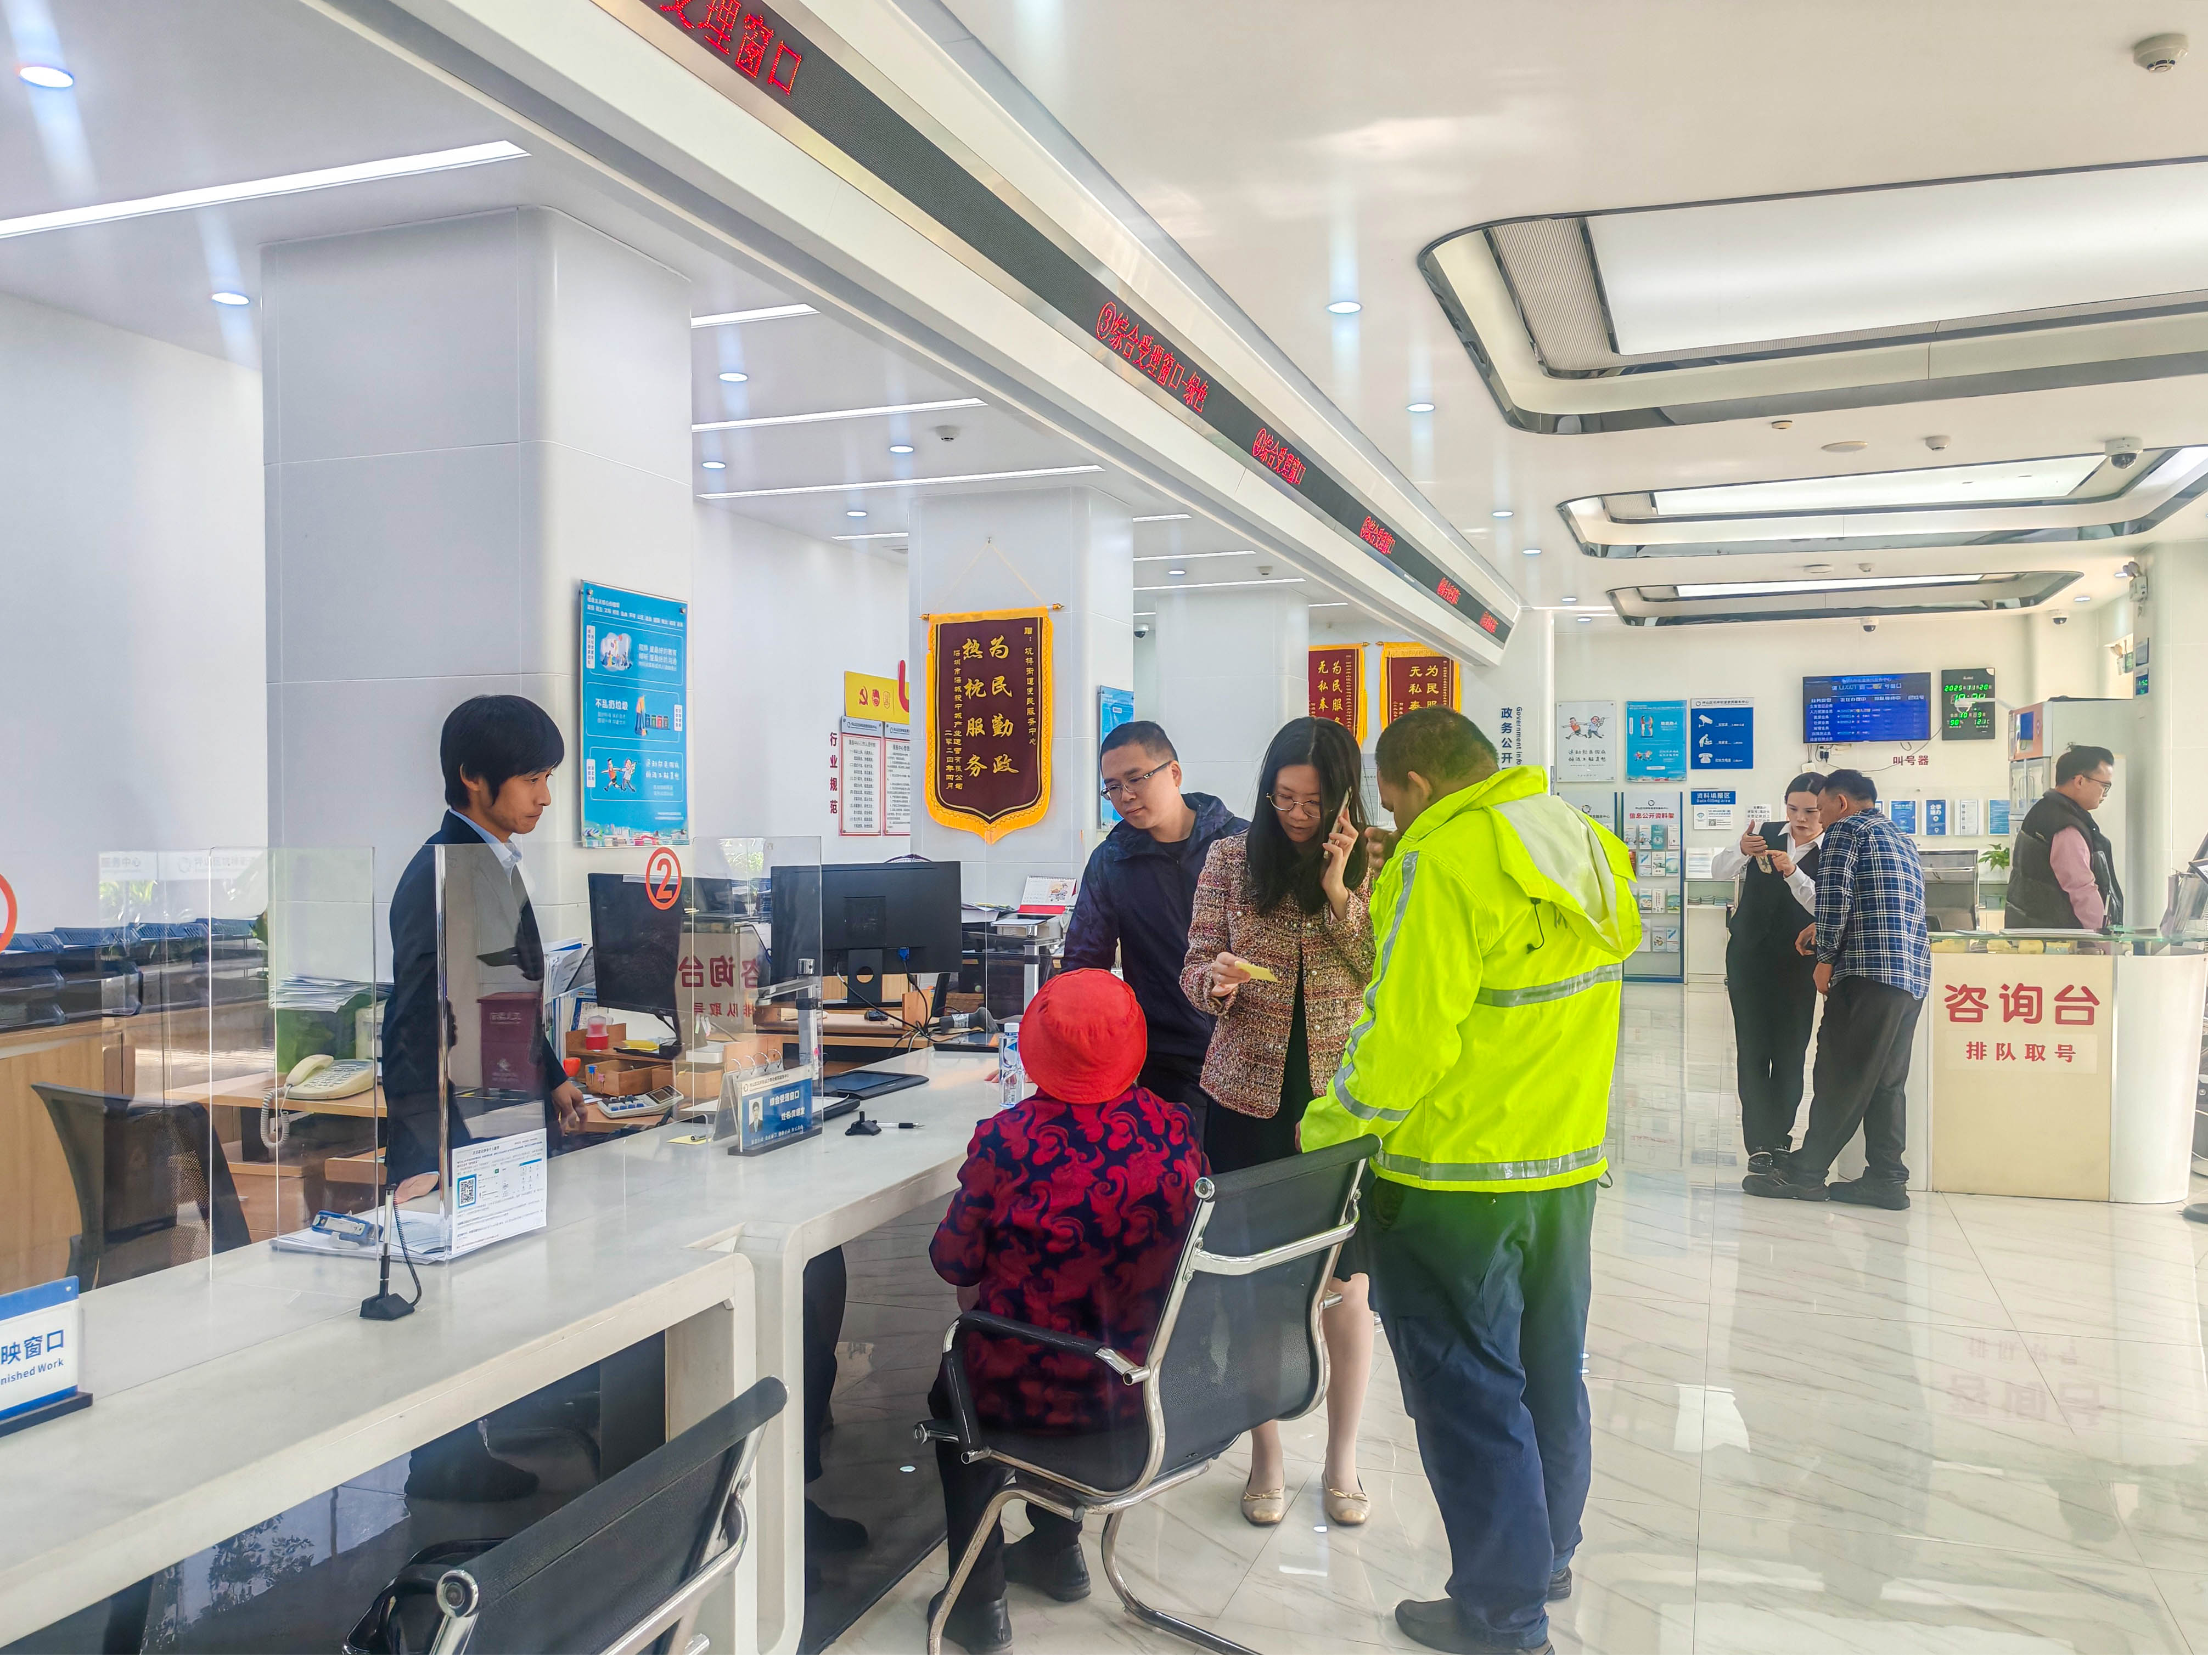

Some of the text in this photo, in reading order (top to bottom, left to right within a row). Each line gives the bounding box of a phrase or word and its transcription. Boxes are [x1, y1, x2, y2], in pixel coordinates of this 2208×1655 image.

[595, 698, 629, 711] 不乱扔垃圾
[989, 635, 1019, 774] 为民勤政
[1501, 707, 1513, 770] 政务公开
[829, 732, 838, 814] 行业规范
[1892, 755, 1929, 766] 叫号器
[1944, 982, 2101, 1026] 咨询台
[1966, 1041, 2077, 1063] 排队取号
[1, 1329, 65, 1366] 映窗口
[38, 1358, 64, 1373] Work
